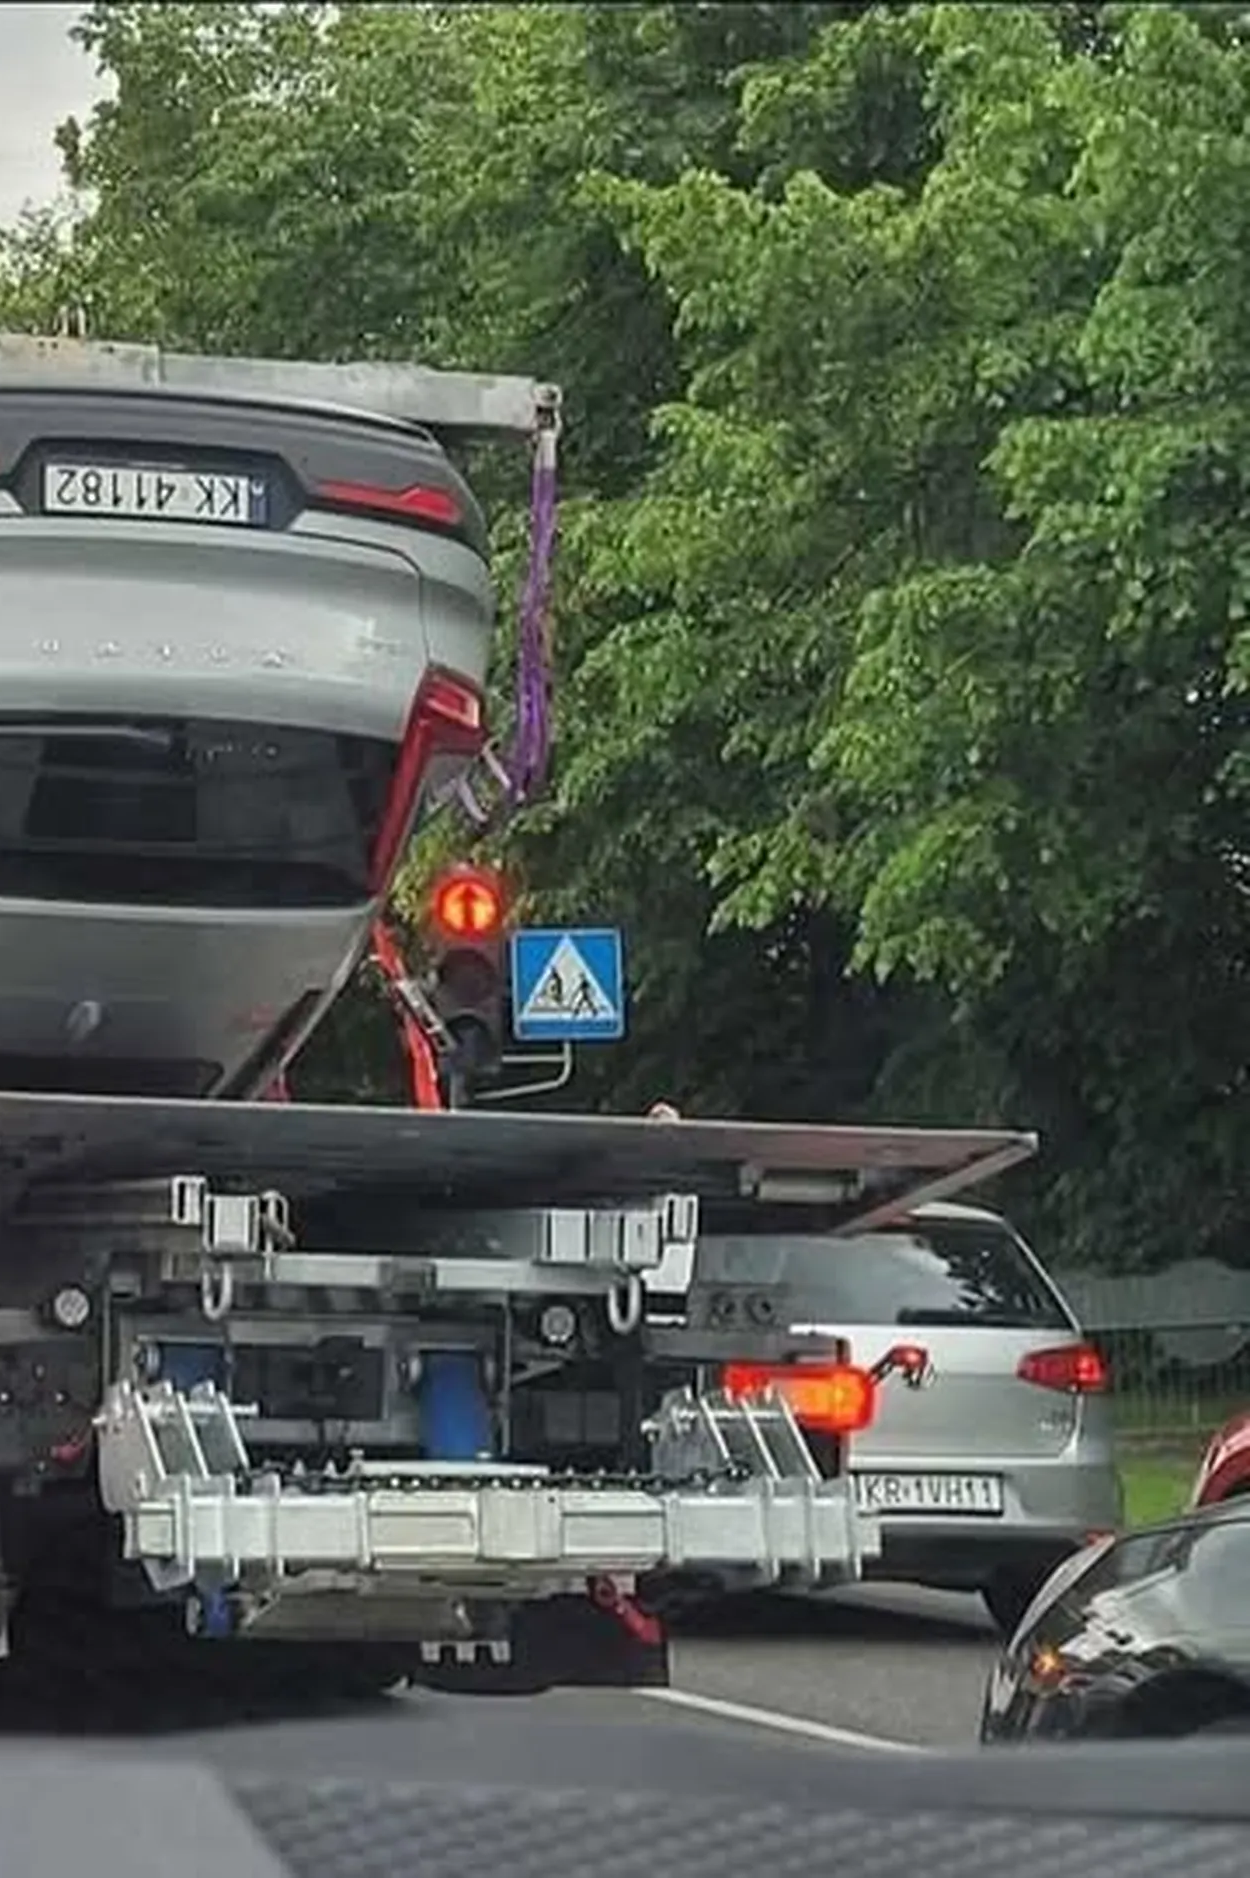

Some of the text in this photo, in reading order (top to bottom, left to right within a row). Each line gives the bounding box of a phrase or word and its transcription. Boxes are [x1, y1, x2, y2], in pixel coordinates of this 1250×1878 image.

[56, 468, 241, 515] KK 41182
[864, 1478, 901, 1506] KR
